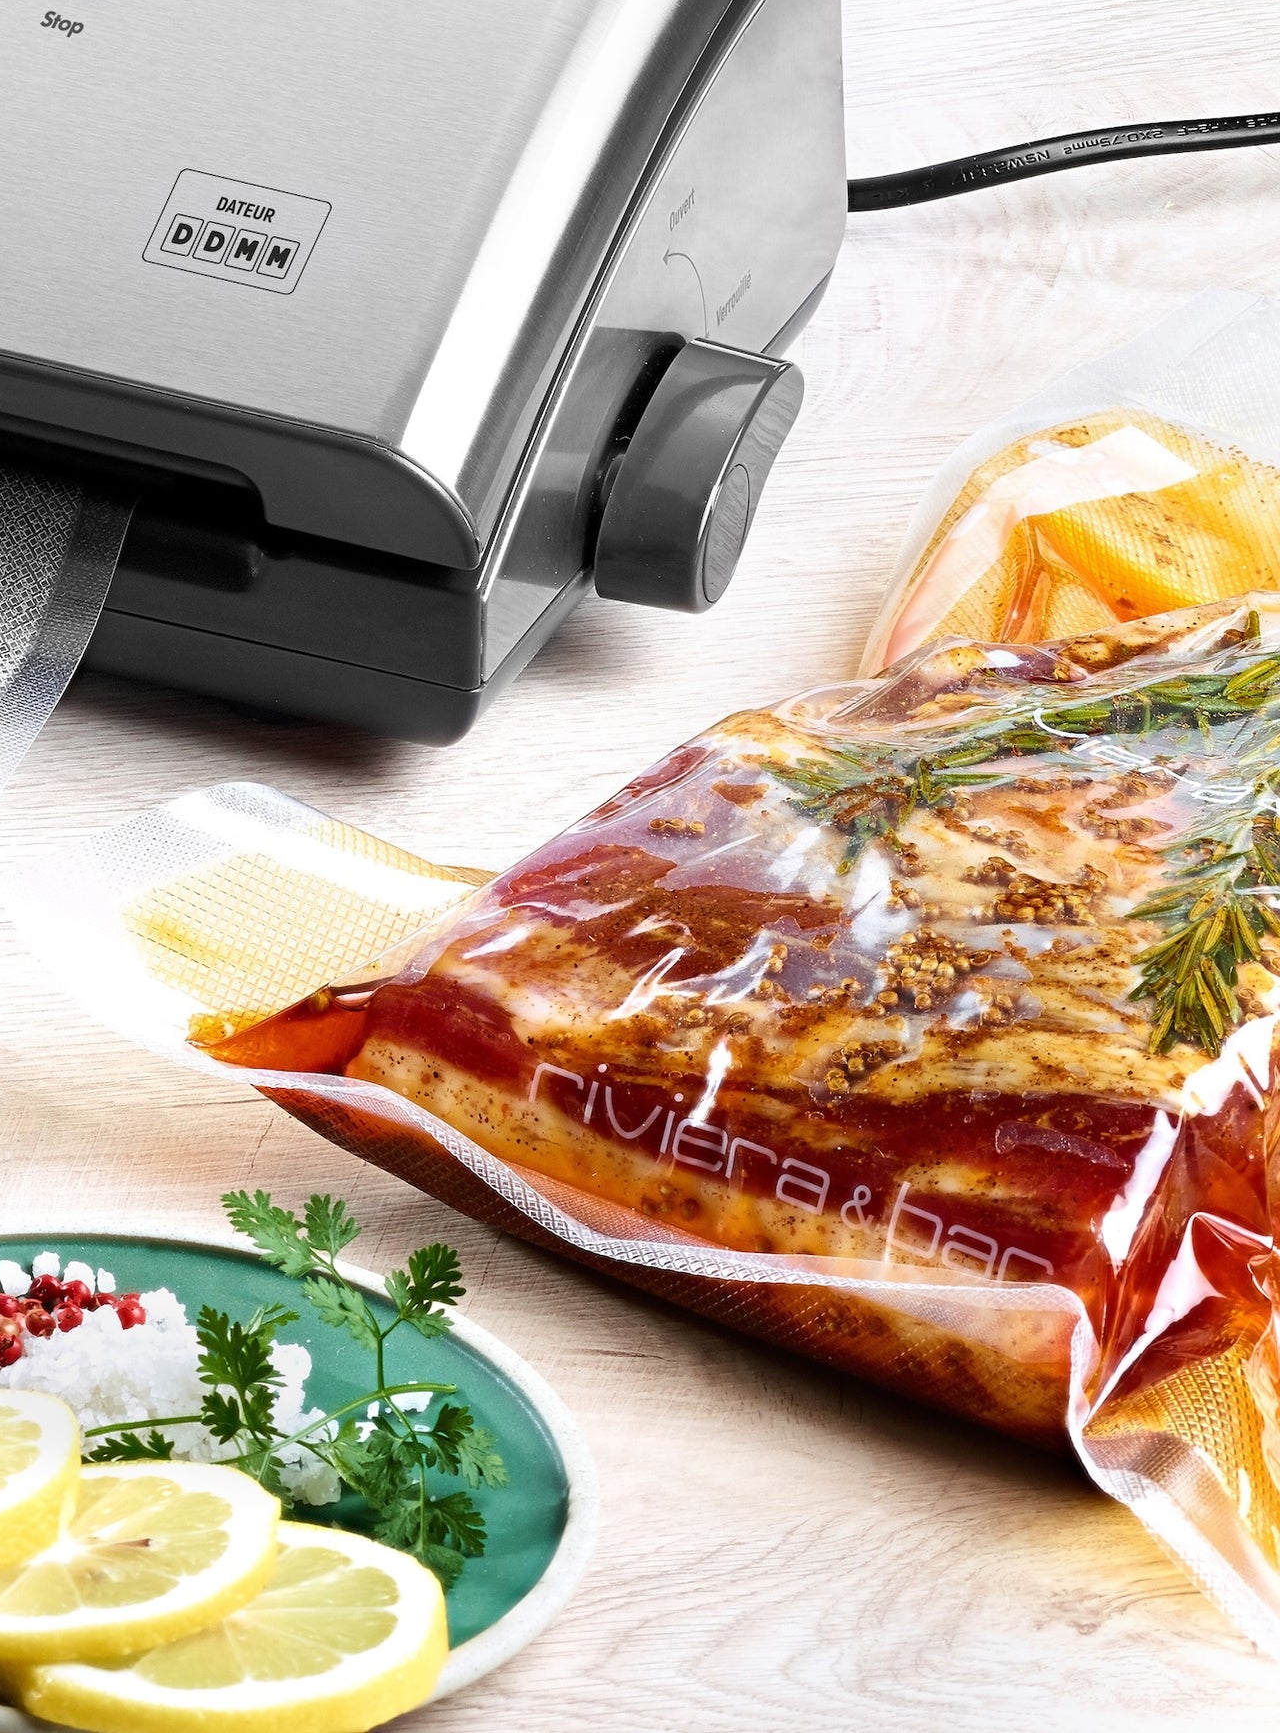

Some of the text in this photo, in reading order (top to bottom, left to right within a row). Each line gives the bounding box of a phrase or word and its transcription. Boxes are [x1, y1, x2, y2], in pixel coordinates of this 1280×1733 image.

[40, 10, 85, 38] Stop
[215, 196, 276, 224] DATEUR
[669, 187, 695, 232] Ouvert
[715, 269, 752, 327] Verrouillé
[528, 1062, 1055, 1282] riviera & bar
